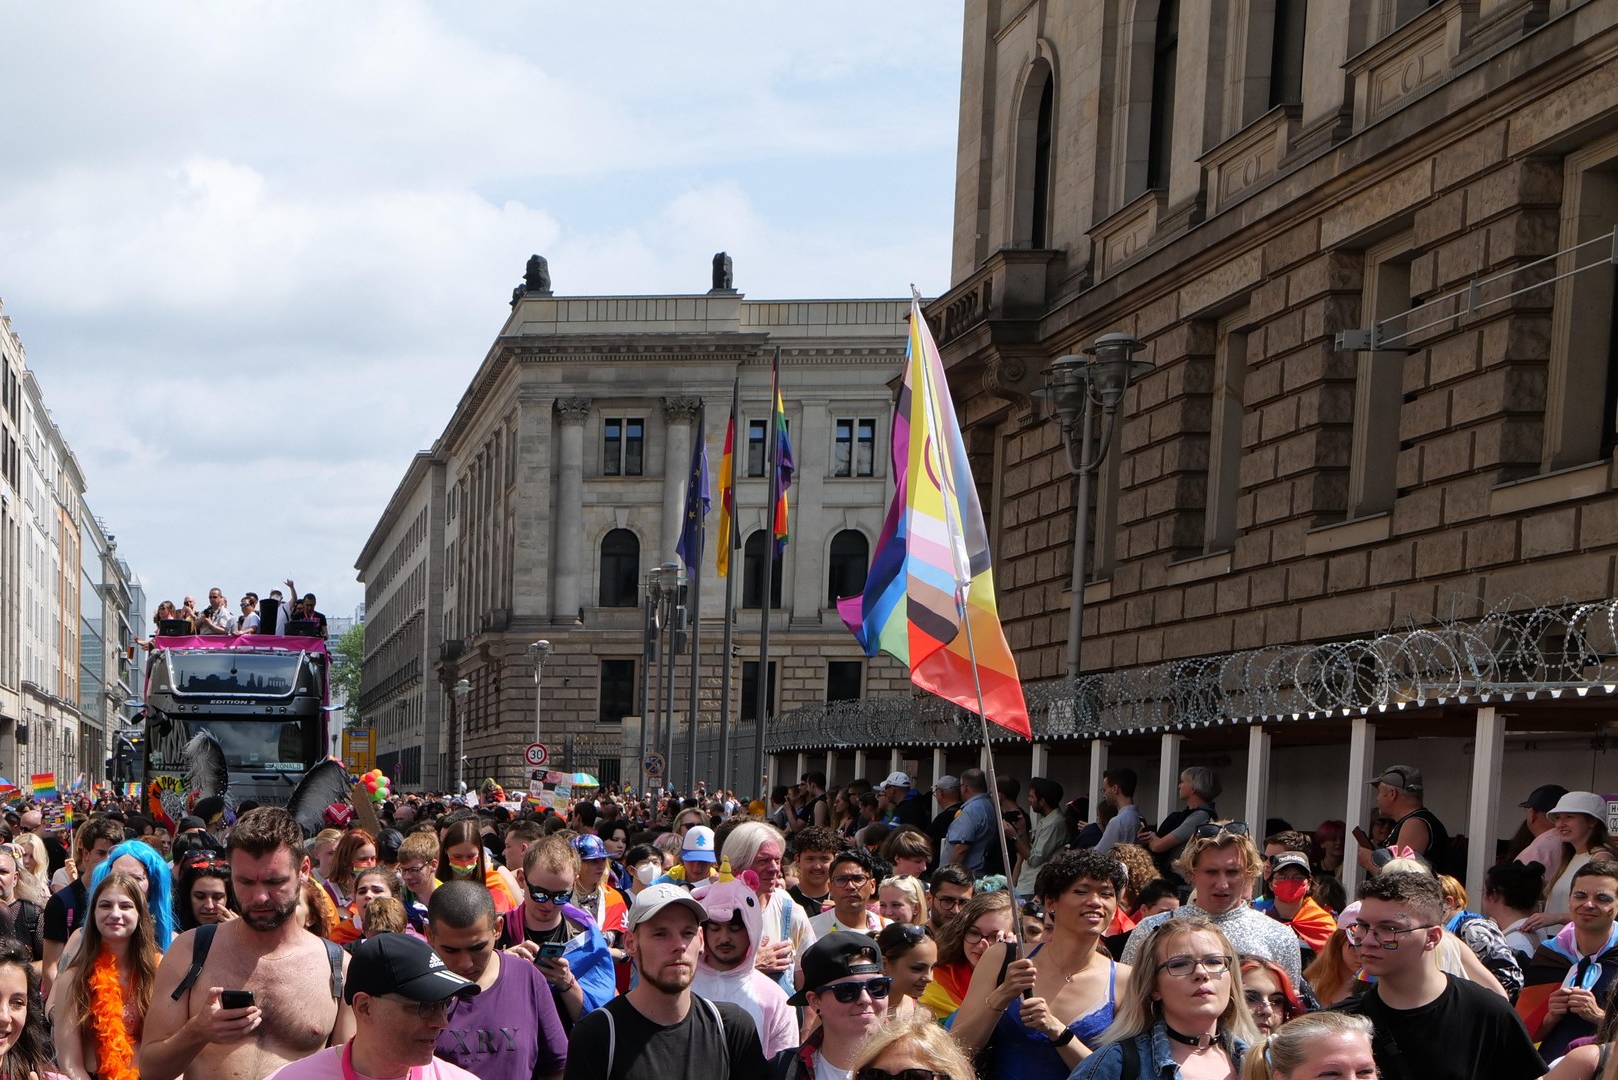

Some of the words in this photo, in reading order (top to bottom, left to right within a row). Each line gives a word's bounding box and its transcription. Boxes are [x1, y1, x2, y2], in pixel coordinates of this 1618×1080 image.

[530, 749, 543, 760] 30
[1278, 855, 1306, 864] adidas
[450, 1027, 520, 1055] XRY
